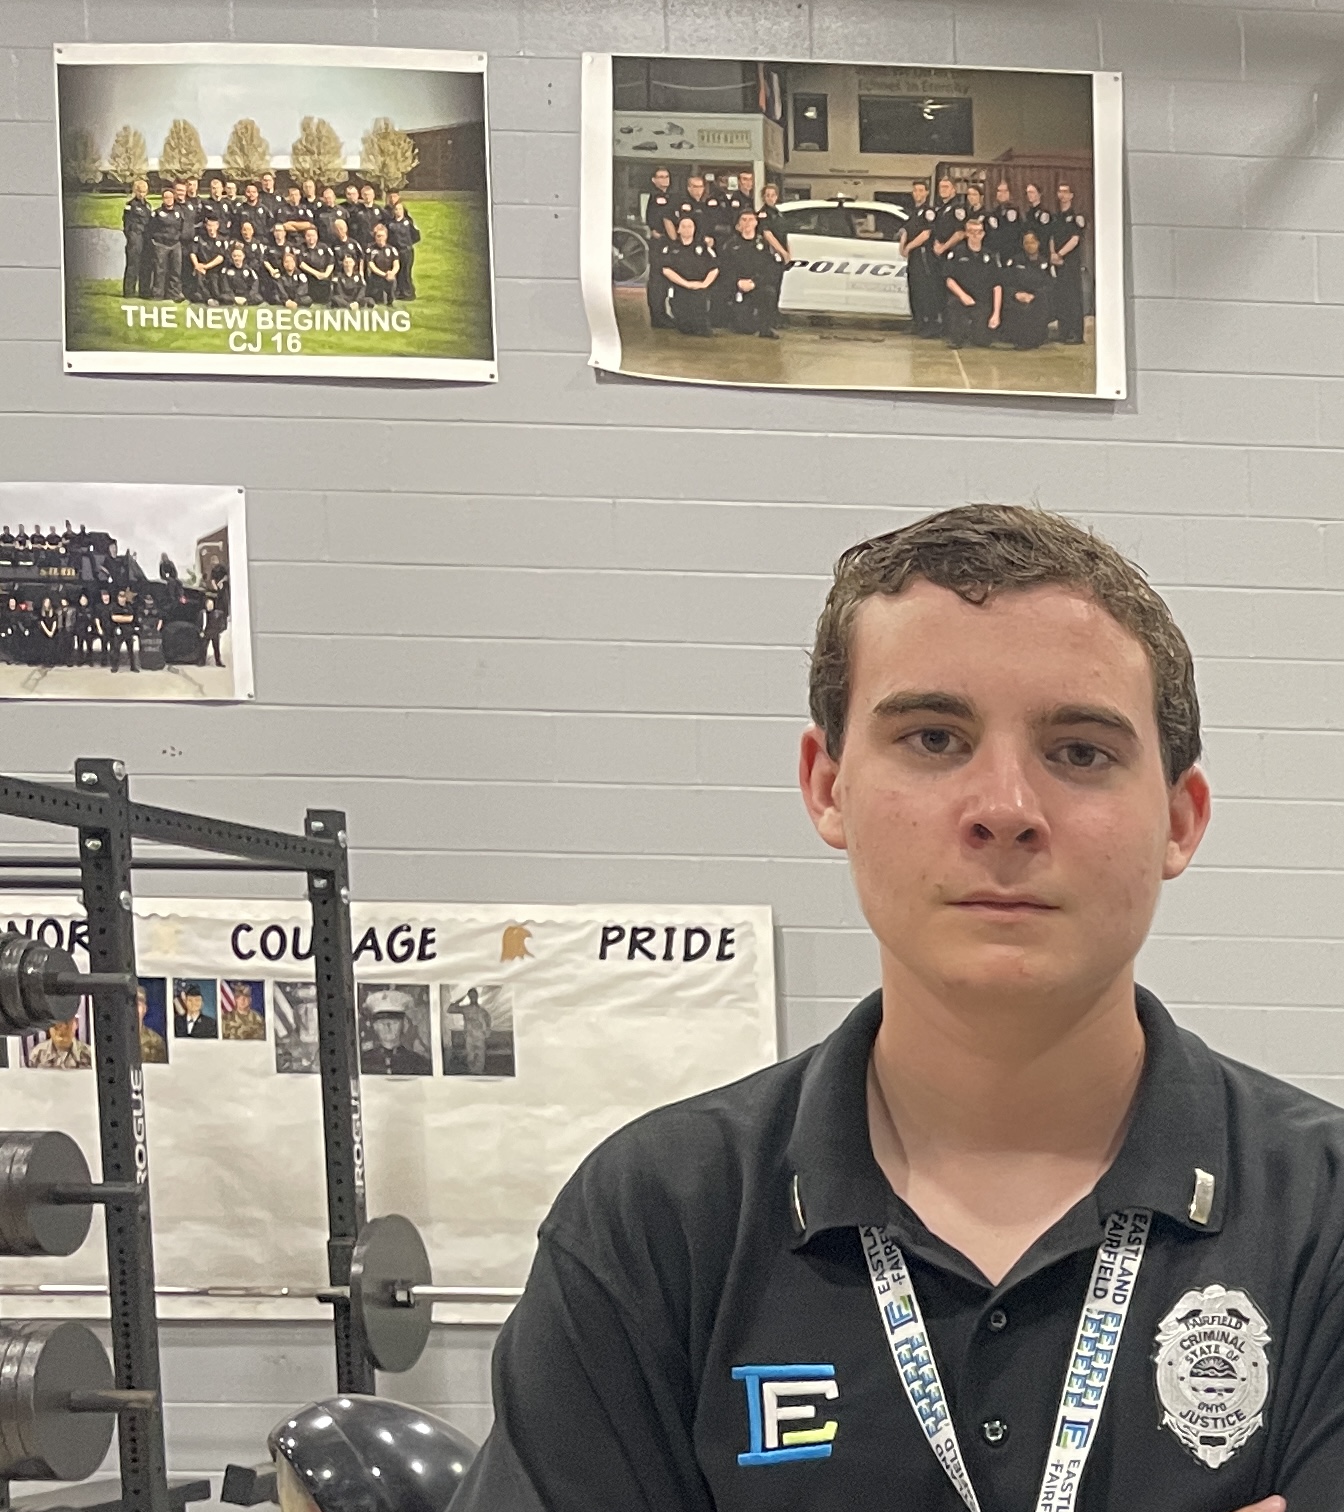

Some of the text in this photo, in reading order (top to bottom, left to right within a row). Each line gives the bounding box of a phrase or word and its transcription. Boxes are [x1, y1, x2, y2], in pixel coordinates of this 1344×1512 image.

[121, 305, 411, 332] THE NEW BEGINNING
[229, 332, 302, 353] CJ 16
[231, 923, 437, 962] COUAGE
[599, 925, 736, 961] PRIDE
[1112, 1212, 1148, 1305] EASTLAND
[1179, 1330, 1246, 1354] CRIMINAL
[1185, 1344, 1240, 1364] STATE OF
[1179, 1409, 1247, 1428] JUSTICE
